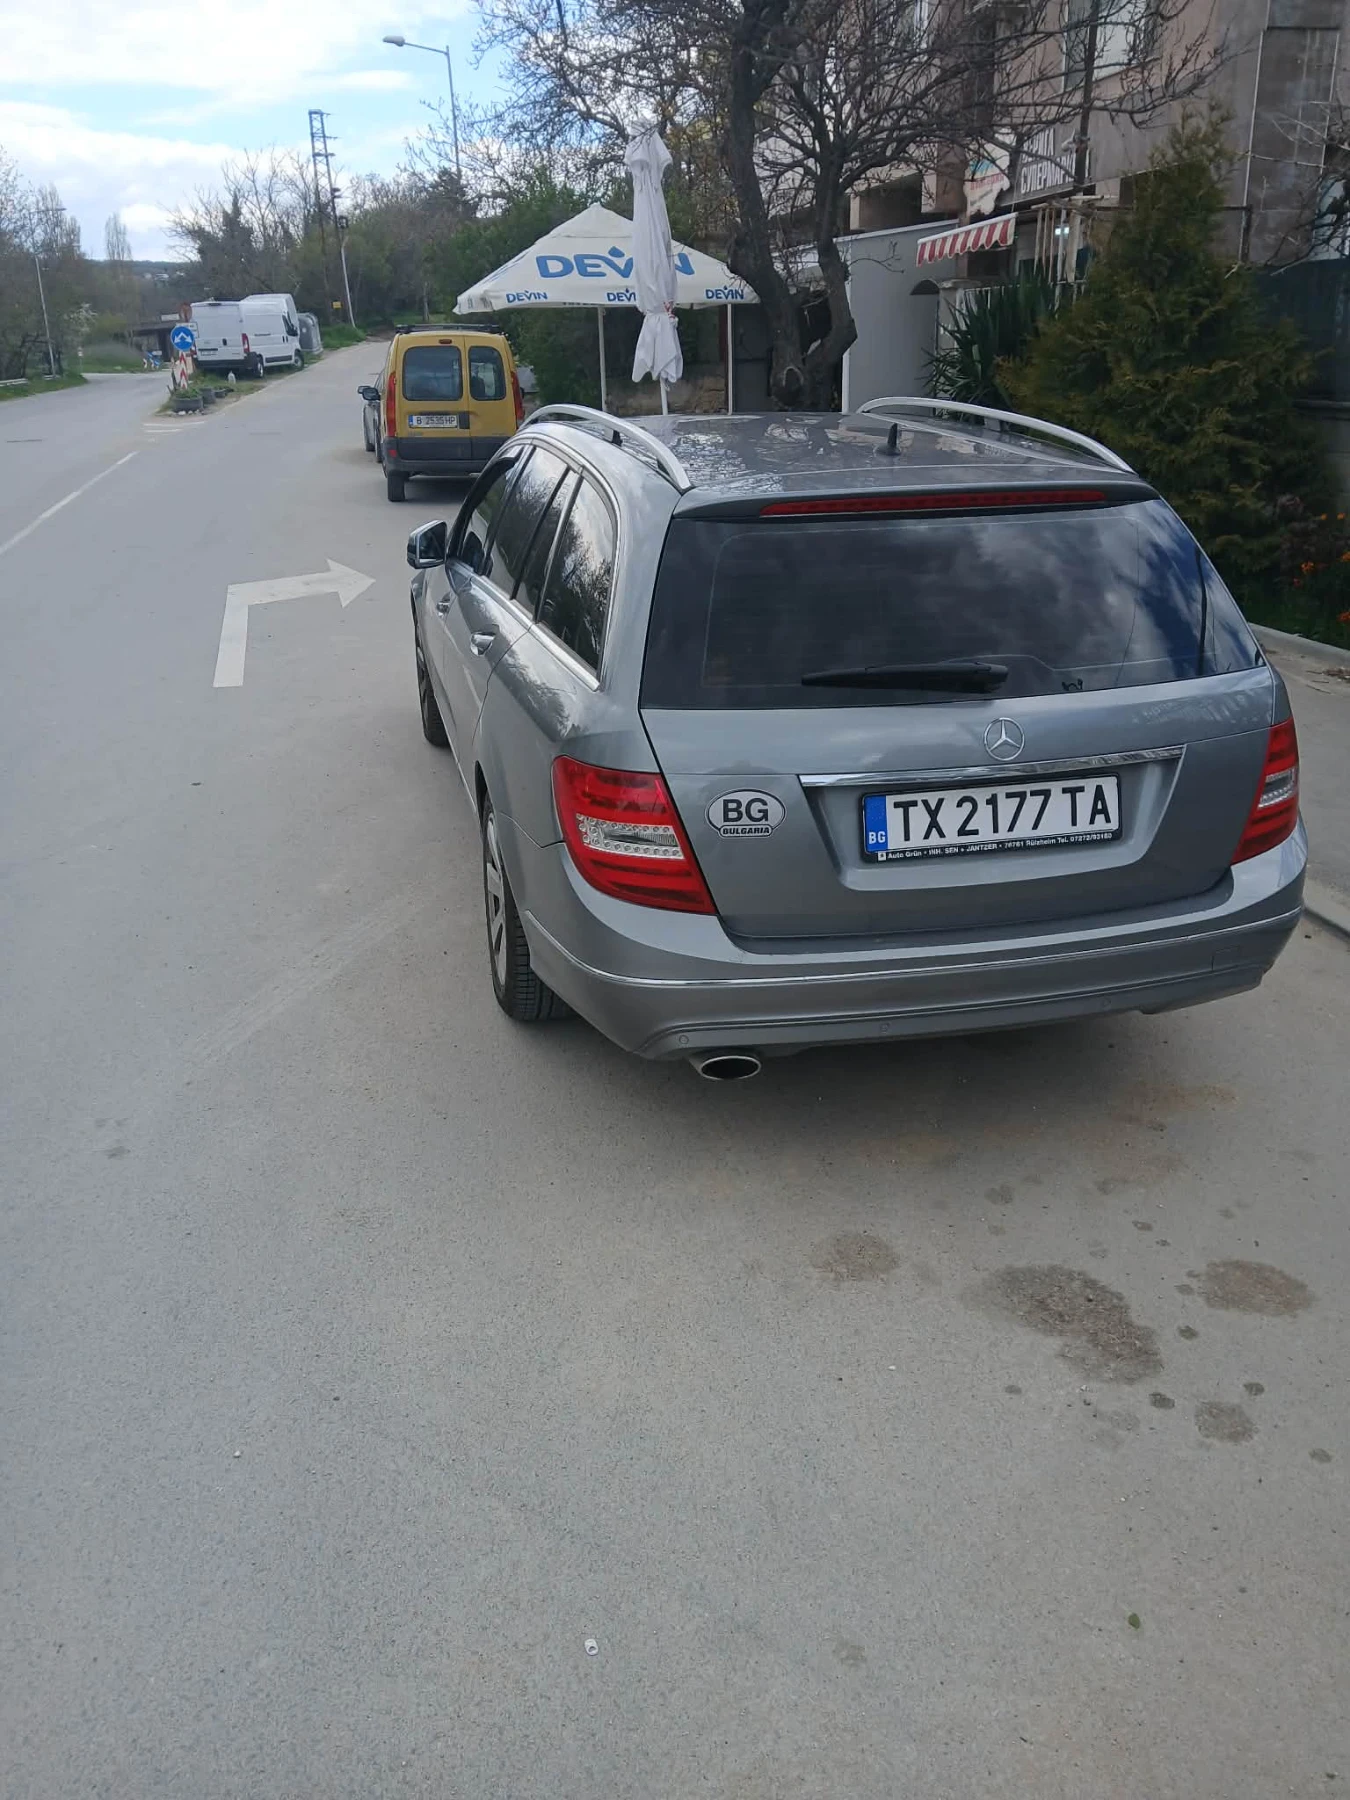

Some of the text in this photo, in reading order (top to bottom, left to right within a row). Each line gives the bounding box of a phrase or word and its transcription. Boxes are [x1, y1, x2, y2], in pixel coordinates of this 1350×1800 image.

[535, 247, 695, 279] DEVN
[506, 290, 548, 304] DEVIN
[606, 289, 637, 302] DEVI
[705, 286, 744, 300] DEVIN
[722, 797, 769, 823] BG
[893, 784, 1112, 842] TX 2177 TA
[722, 827, 770, 835] BULGARIA
[868, 831, 886, 845] BG
[905, 850, 921, 858] Grün
